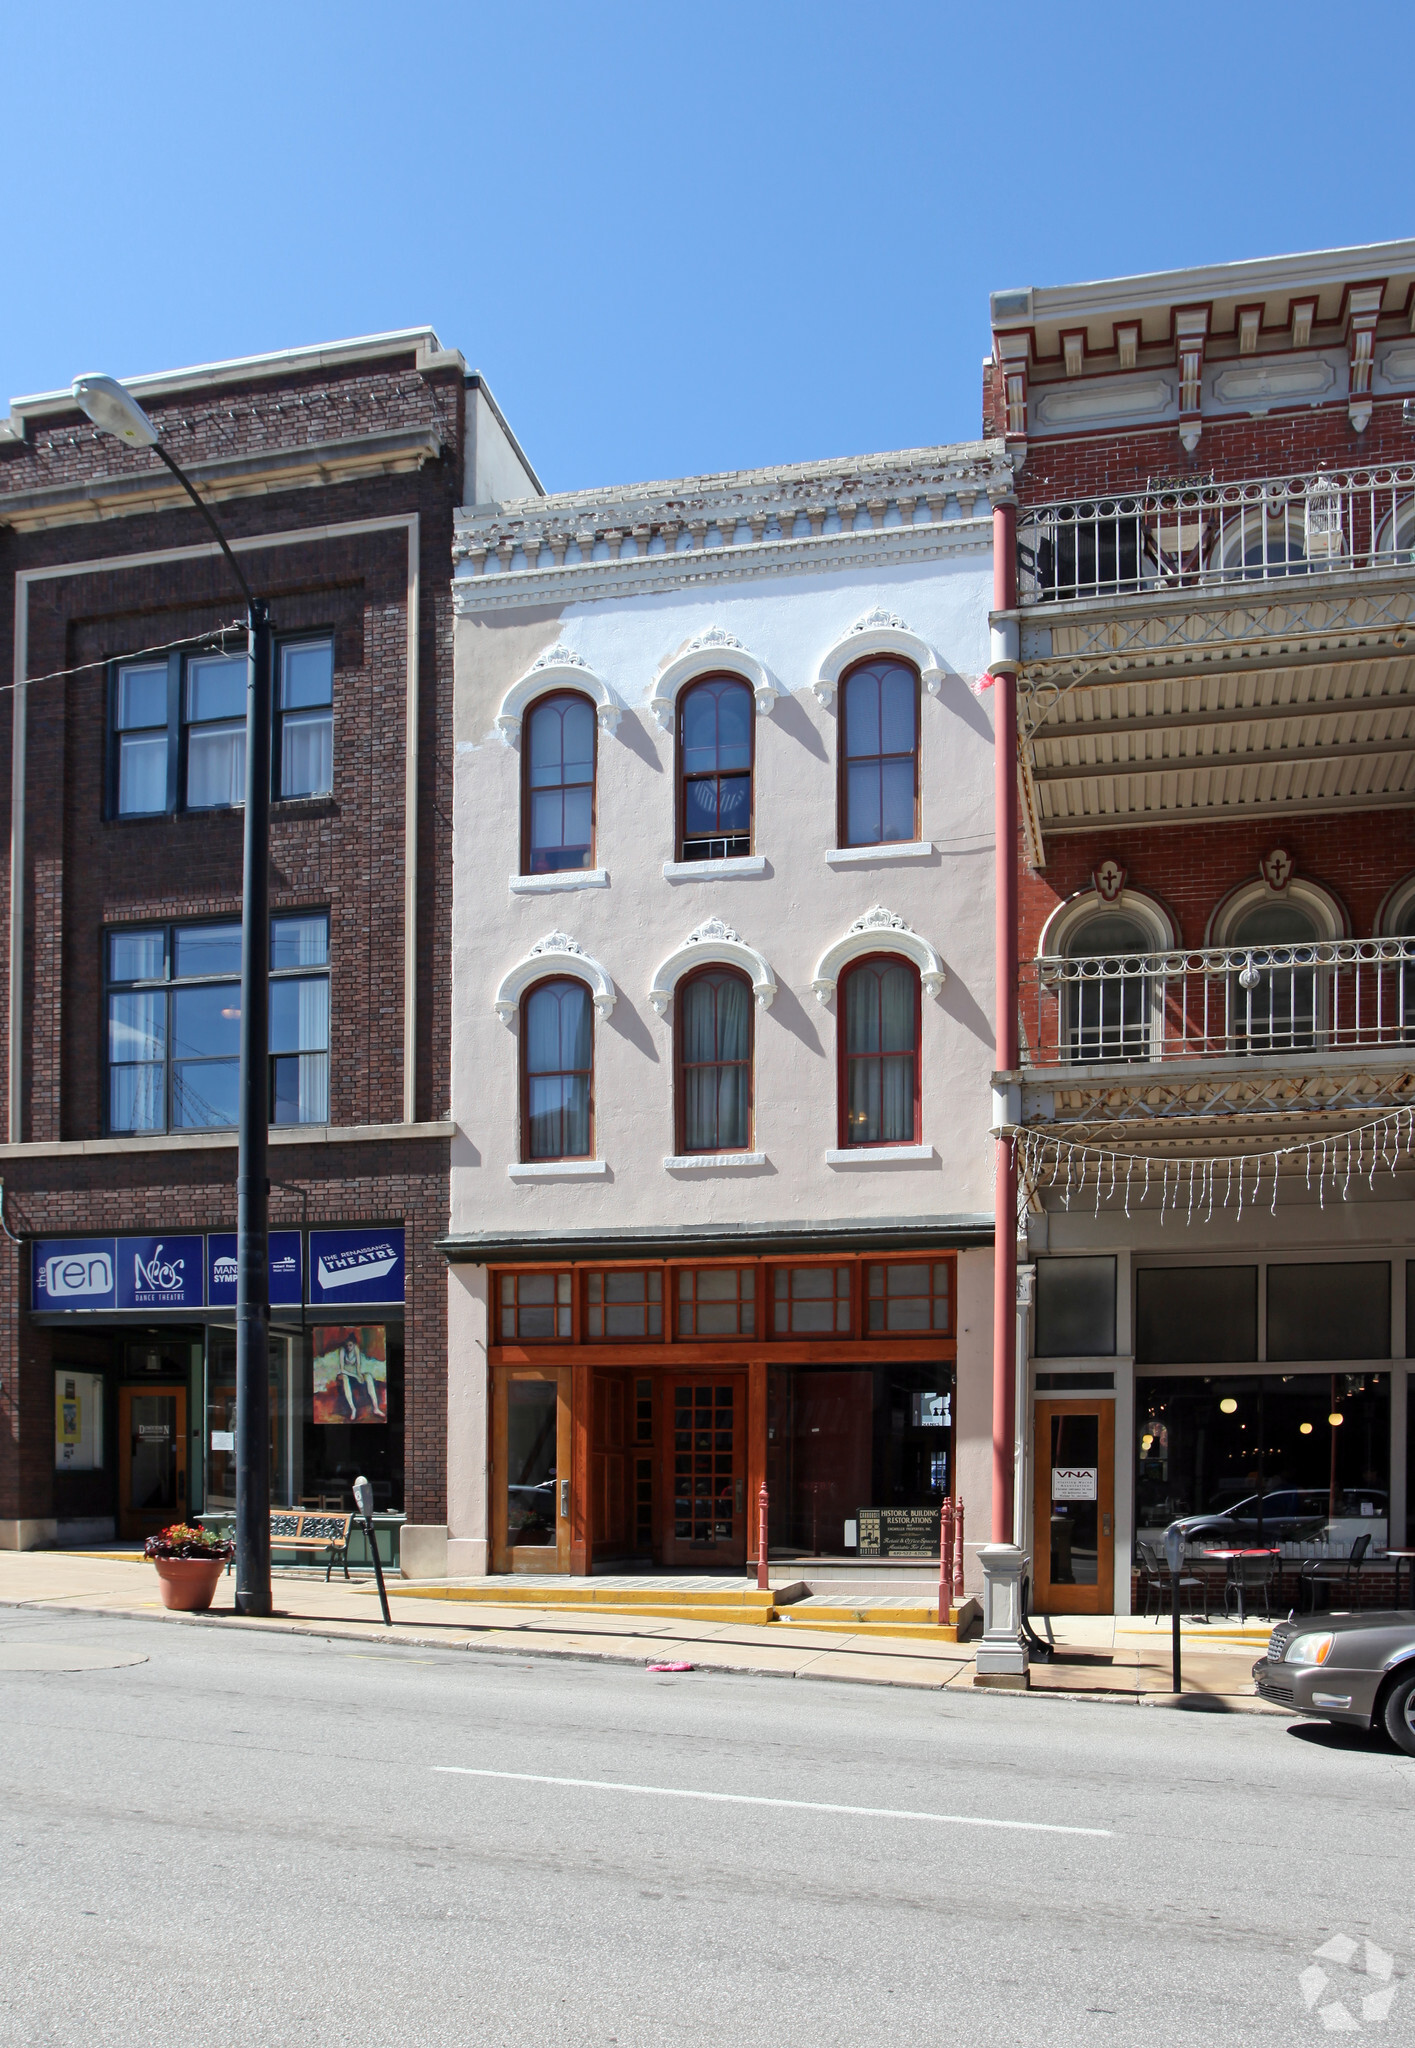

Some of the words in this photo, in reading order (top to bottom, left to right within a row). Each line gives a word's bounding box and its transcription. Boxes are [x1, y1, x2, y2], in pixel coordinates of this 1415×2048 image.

[326, 1248, 396, 1270] THEATRE
[340, 1243, 391, 1258] RENAISSANCE
[36, 1266, 47, 1288] the
[51, 1259, 108, 1291] ren
[135, 1294, 155, 1302] DANCE
[158, 1293, 185, 1301] THEATRE
